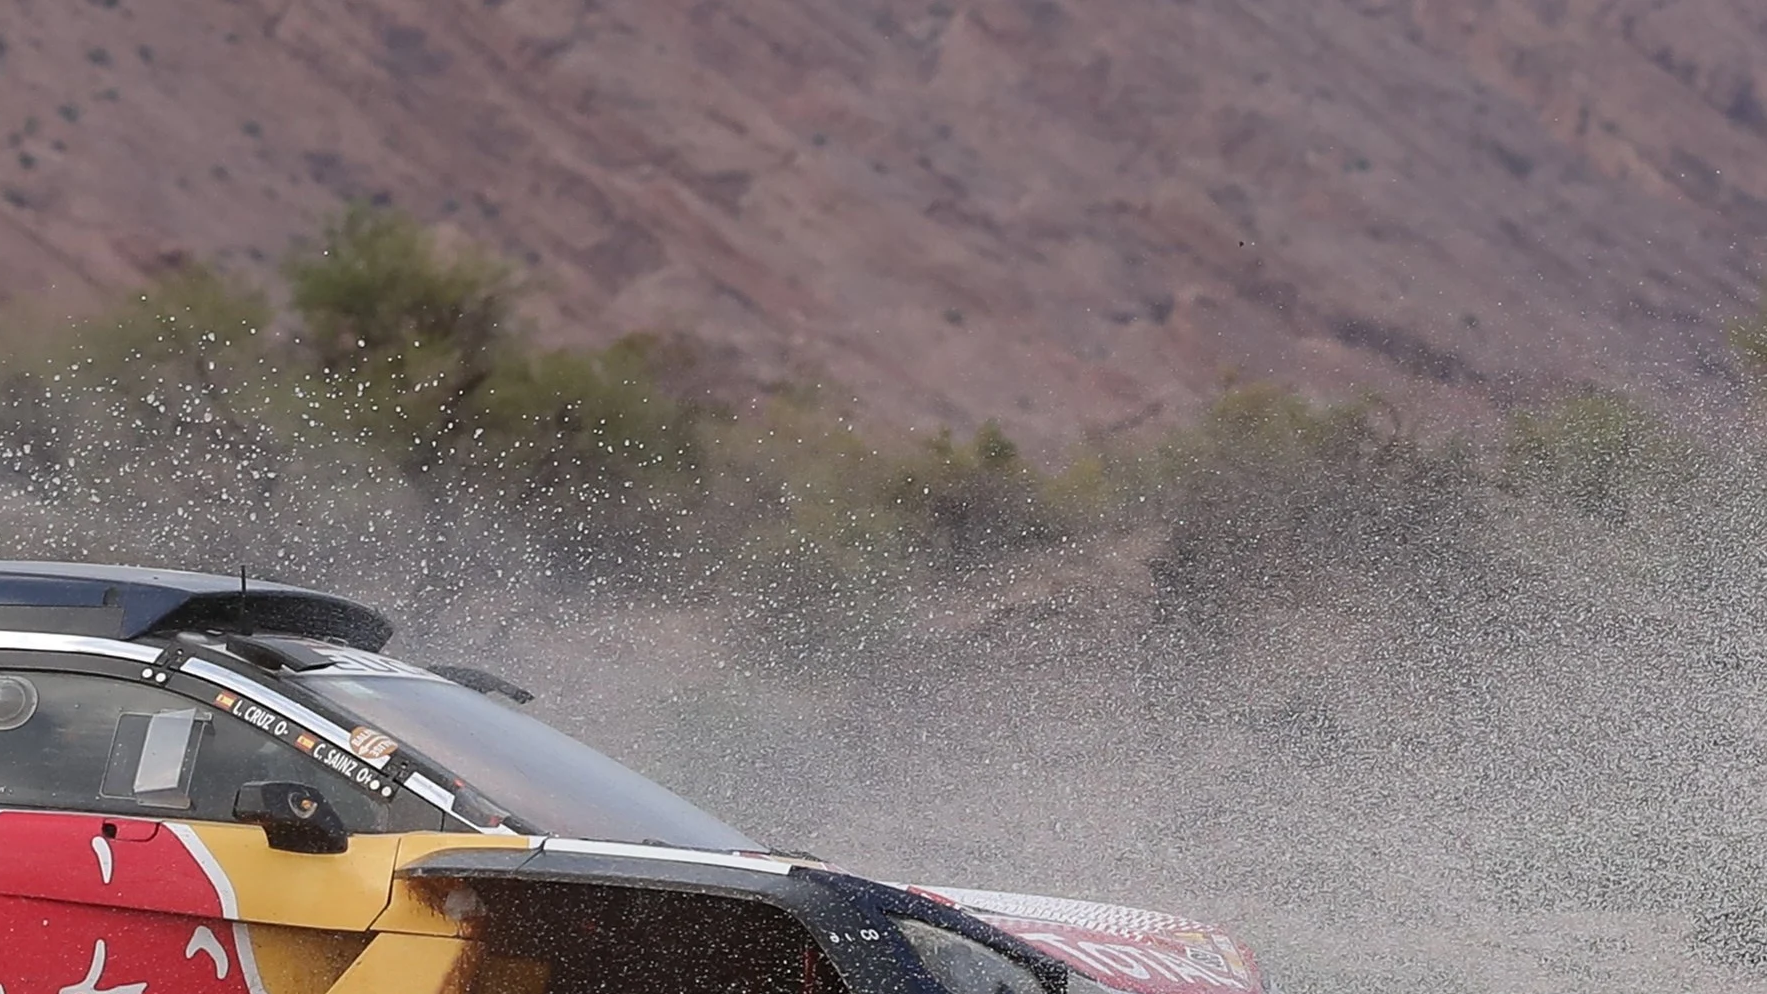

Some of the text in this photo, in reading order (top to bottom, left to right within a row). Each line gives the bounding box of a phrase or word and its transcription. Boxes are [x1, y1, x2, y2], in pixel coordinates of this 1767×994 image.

[233, 700, 242, 716] L.
[244, 706, 276, 731] CRUZ
[313, 743, 323, 761] C.
[324, 747, 359, 777] SAINZ
